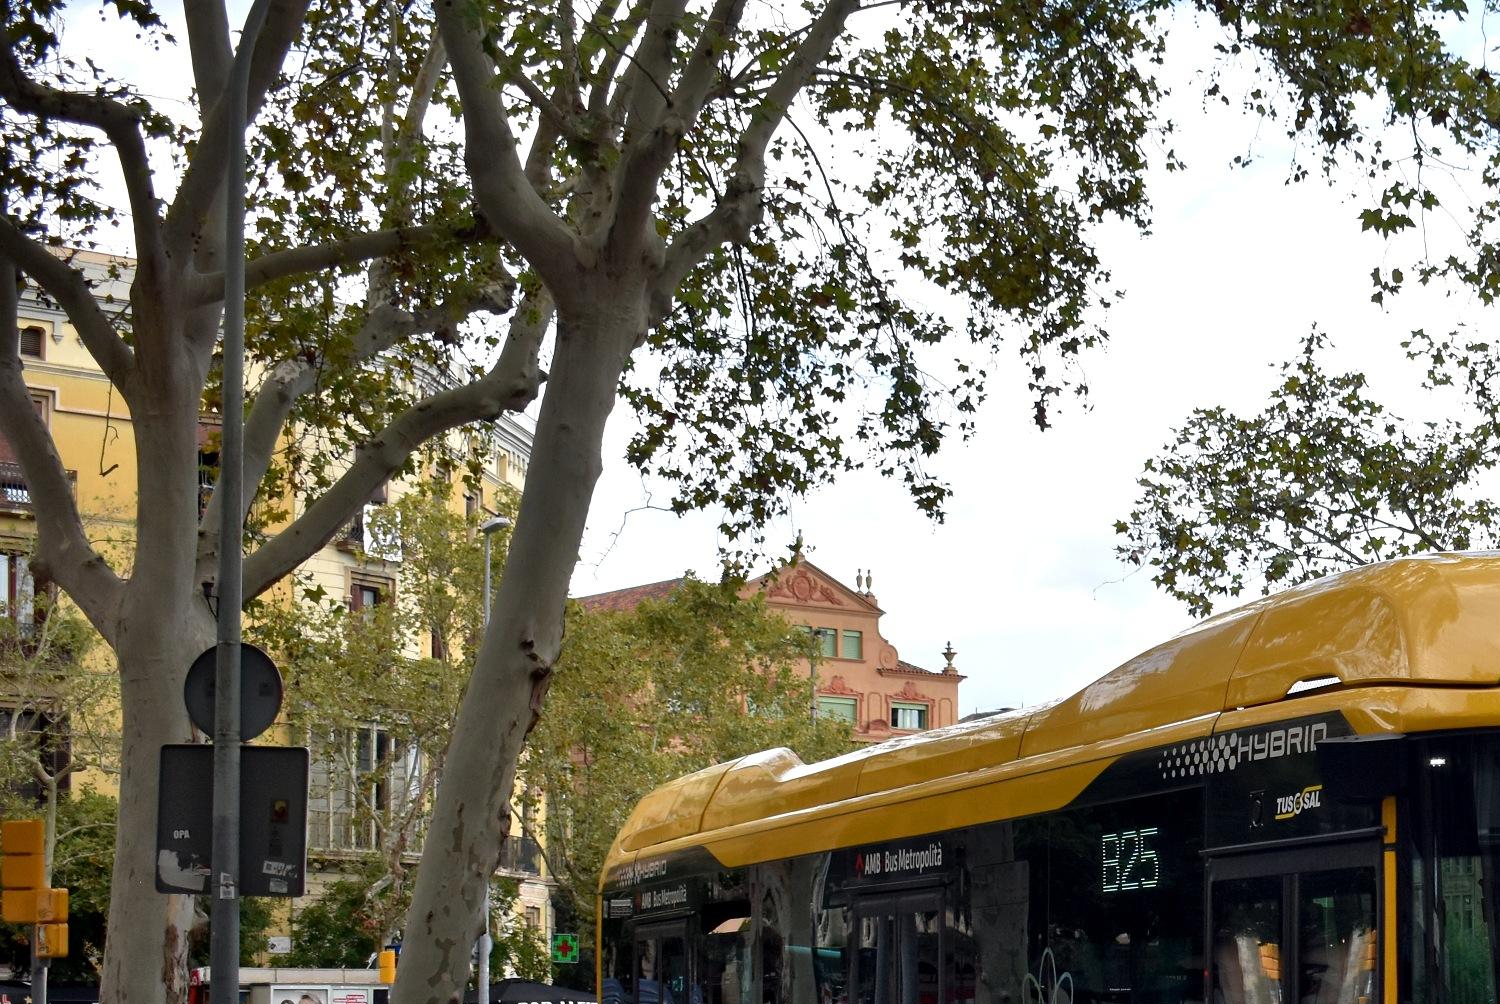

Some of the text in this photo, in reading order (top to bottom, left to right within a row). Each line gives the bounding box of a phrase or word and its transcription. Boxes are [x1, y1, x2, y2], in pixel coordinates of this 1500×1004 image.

[1237, 722, 1327, 763] HYBRID
[173, 829, 190, 839] OPA
[864, 841, 942, 875] AMB Bus Metropolità
[1102, 827, 1158, 892] B25
